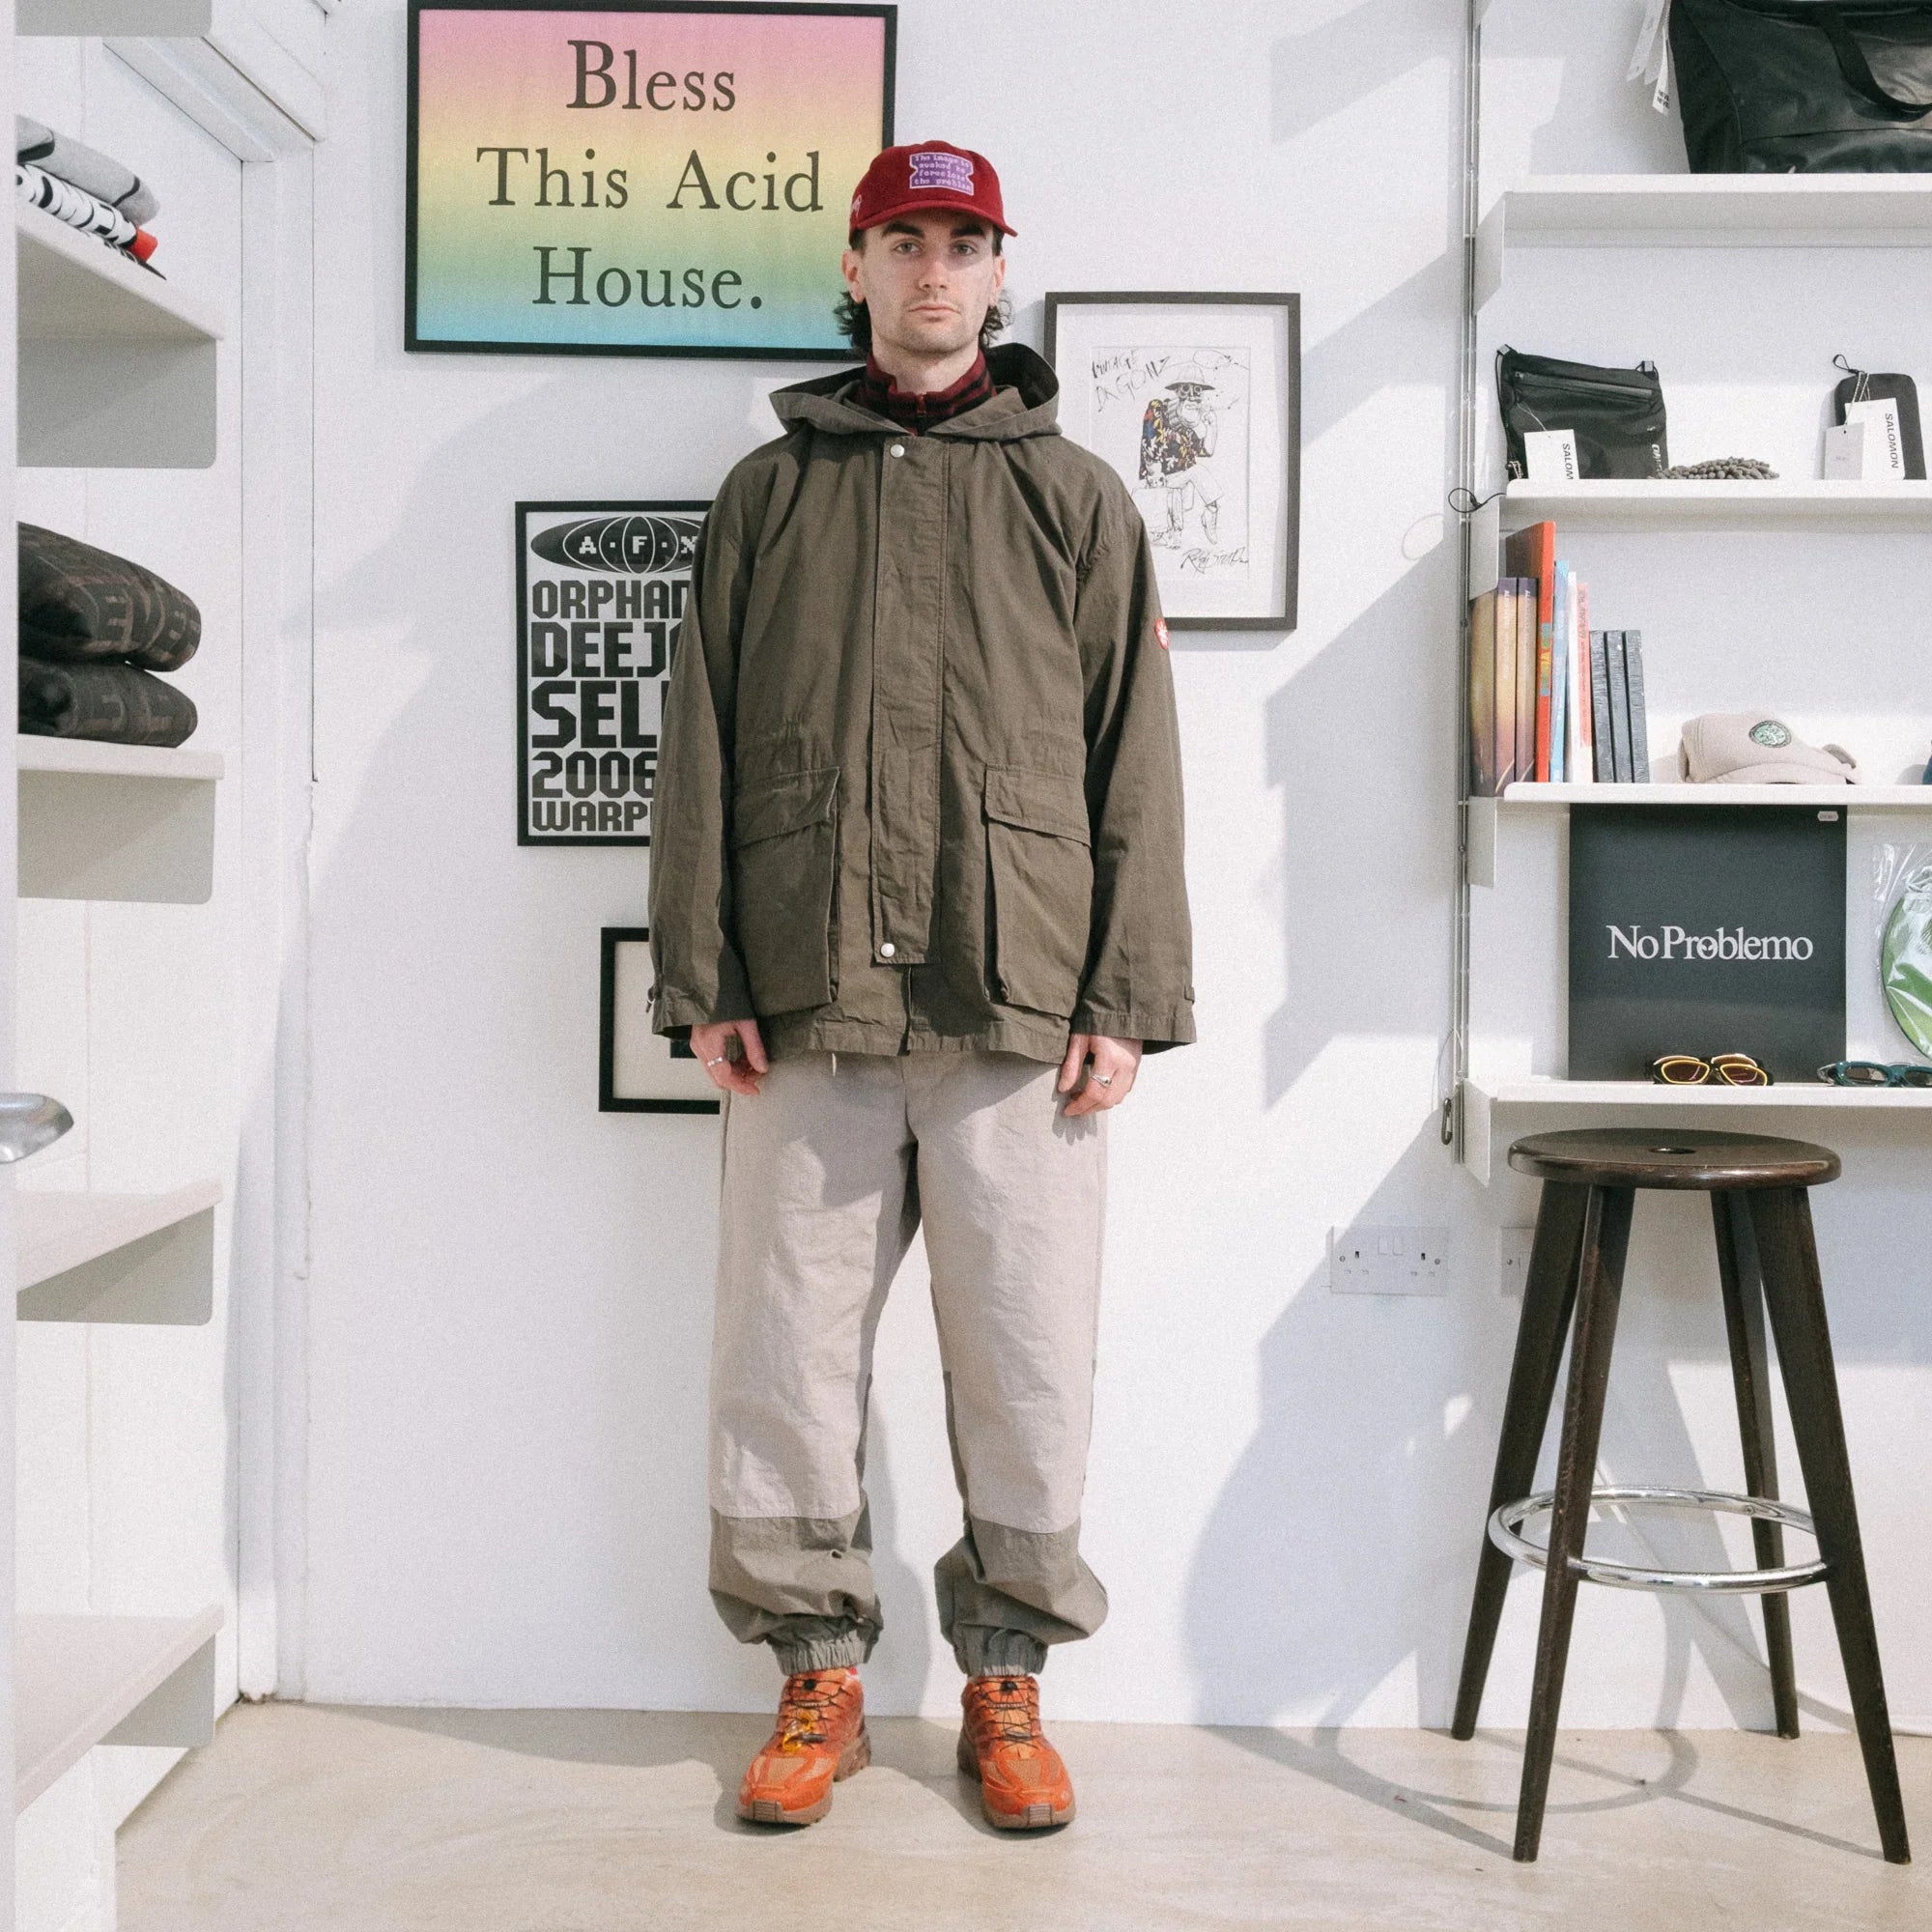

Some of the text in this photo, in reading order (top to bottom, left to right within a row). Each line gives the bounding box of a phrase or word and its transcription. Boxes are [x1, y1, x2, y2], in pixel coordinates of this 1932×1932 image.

[566, 40, 736, 111] Bless
[476, 147, 823, 213] This Acid
[531, 246, 762, 309] House.
[1885, 412, 1899, 469] SALOMON
[531, 621, 681, 677] DEEJ
[531, 680, 670, 748] SEL
[532, 751, 658, 799] 2006
[1605, 924, 1813, 960] No Problemo
